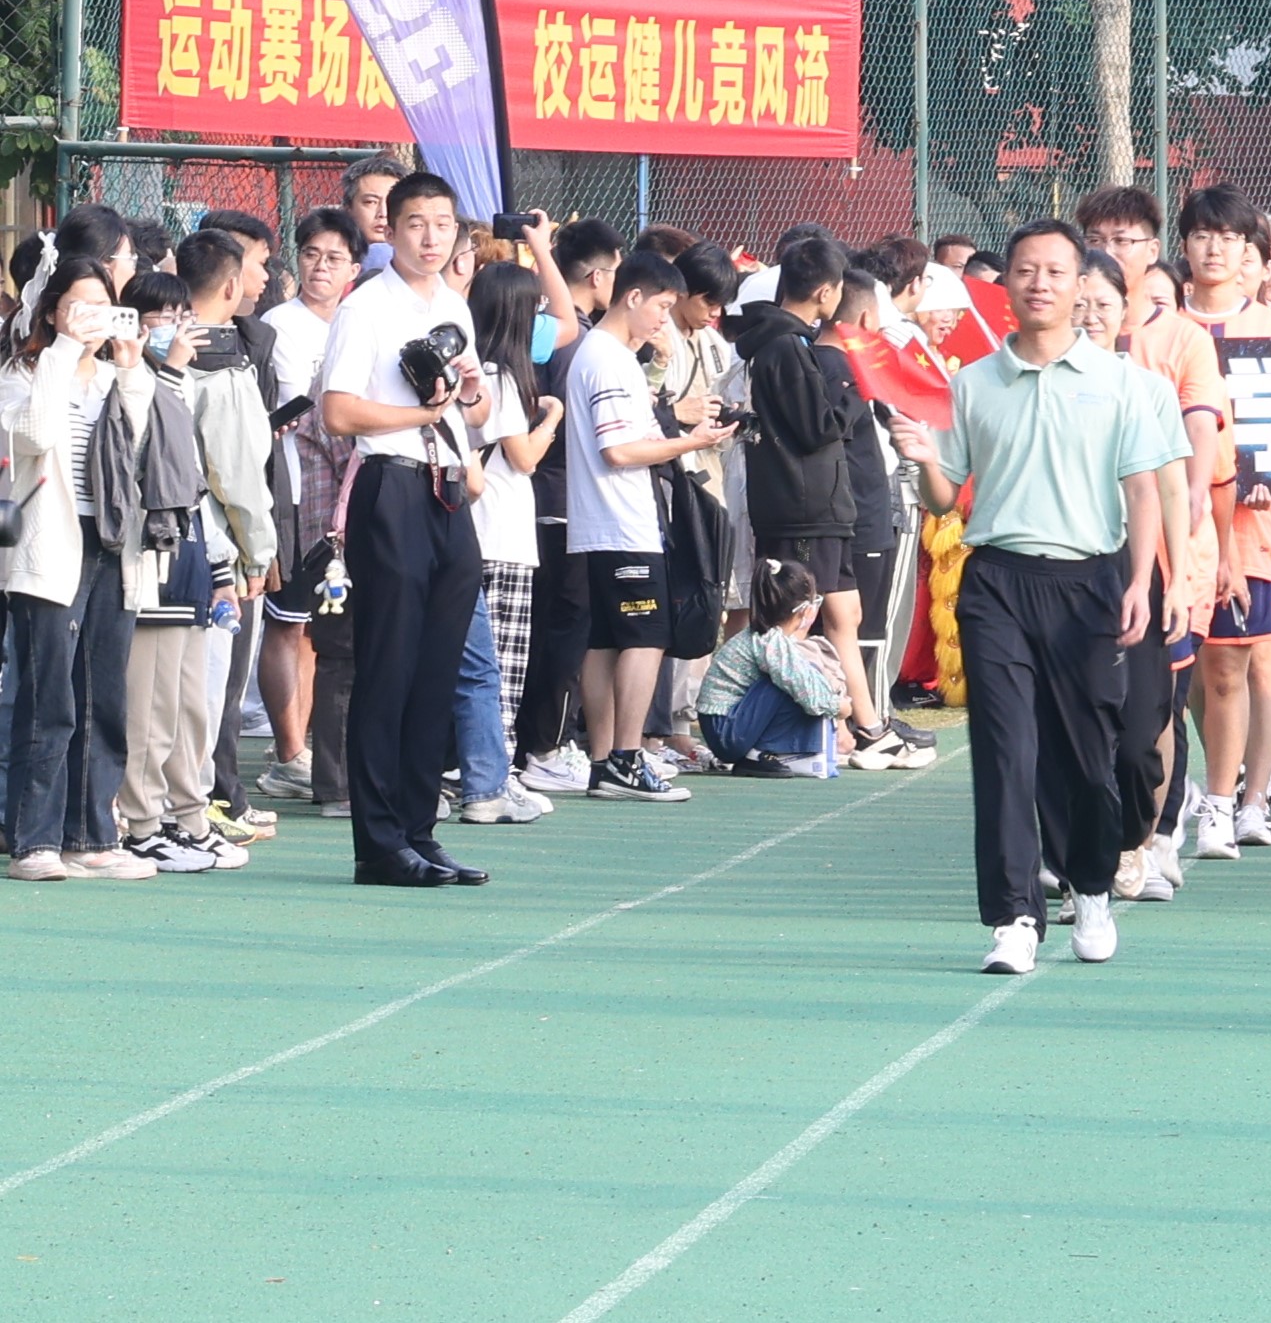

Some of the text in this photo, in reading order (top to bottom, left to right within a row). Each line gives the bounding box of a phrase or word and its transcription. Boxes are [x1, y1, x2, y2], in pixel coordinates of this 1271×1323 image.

[533, 9, 831, 128] 校运健儿竞风流
